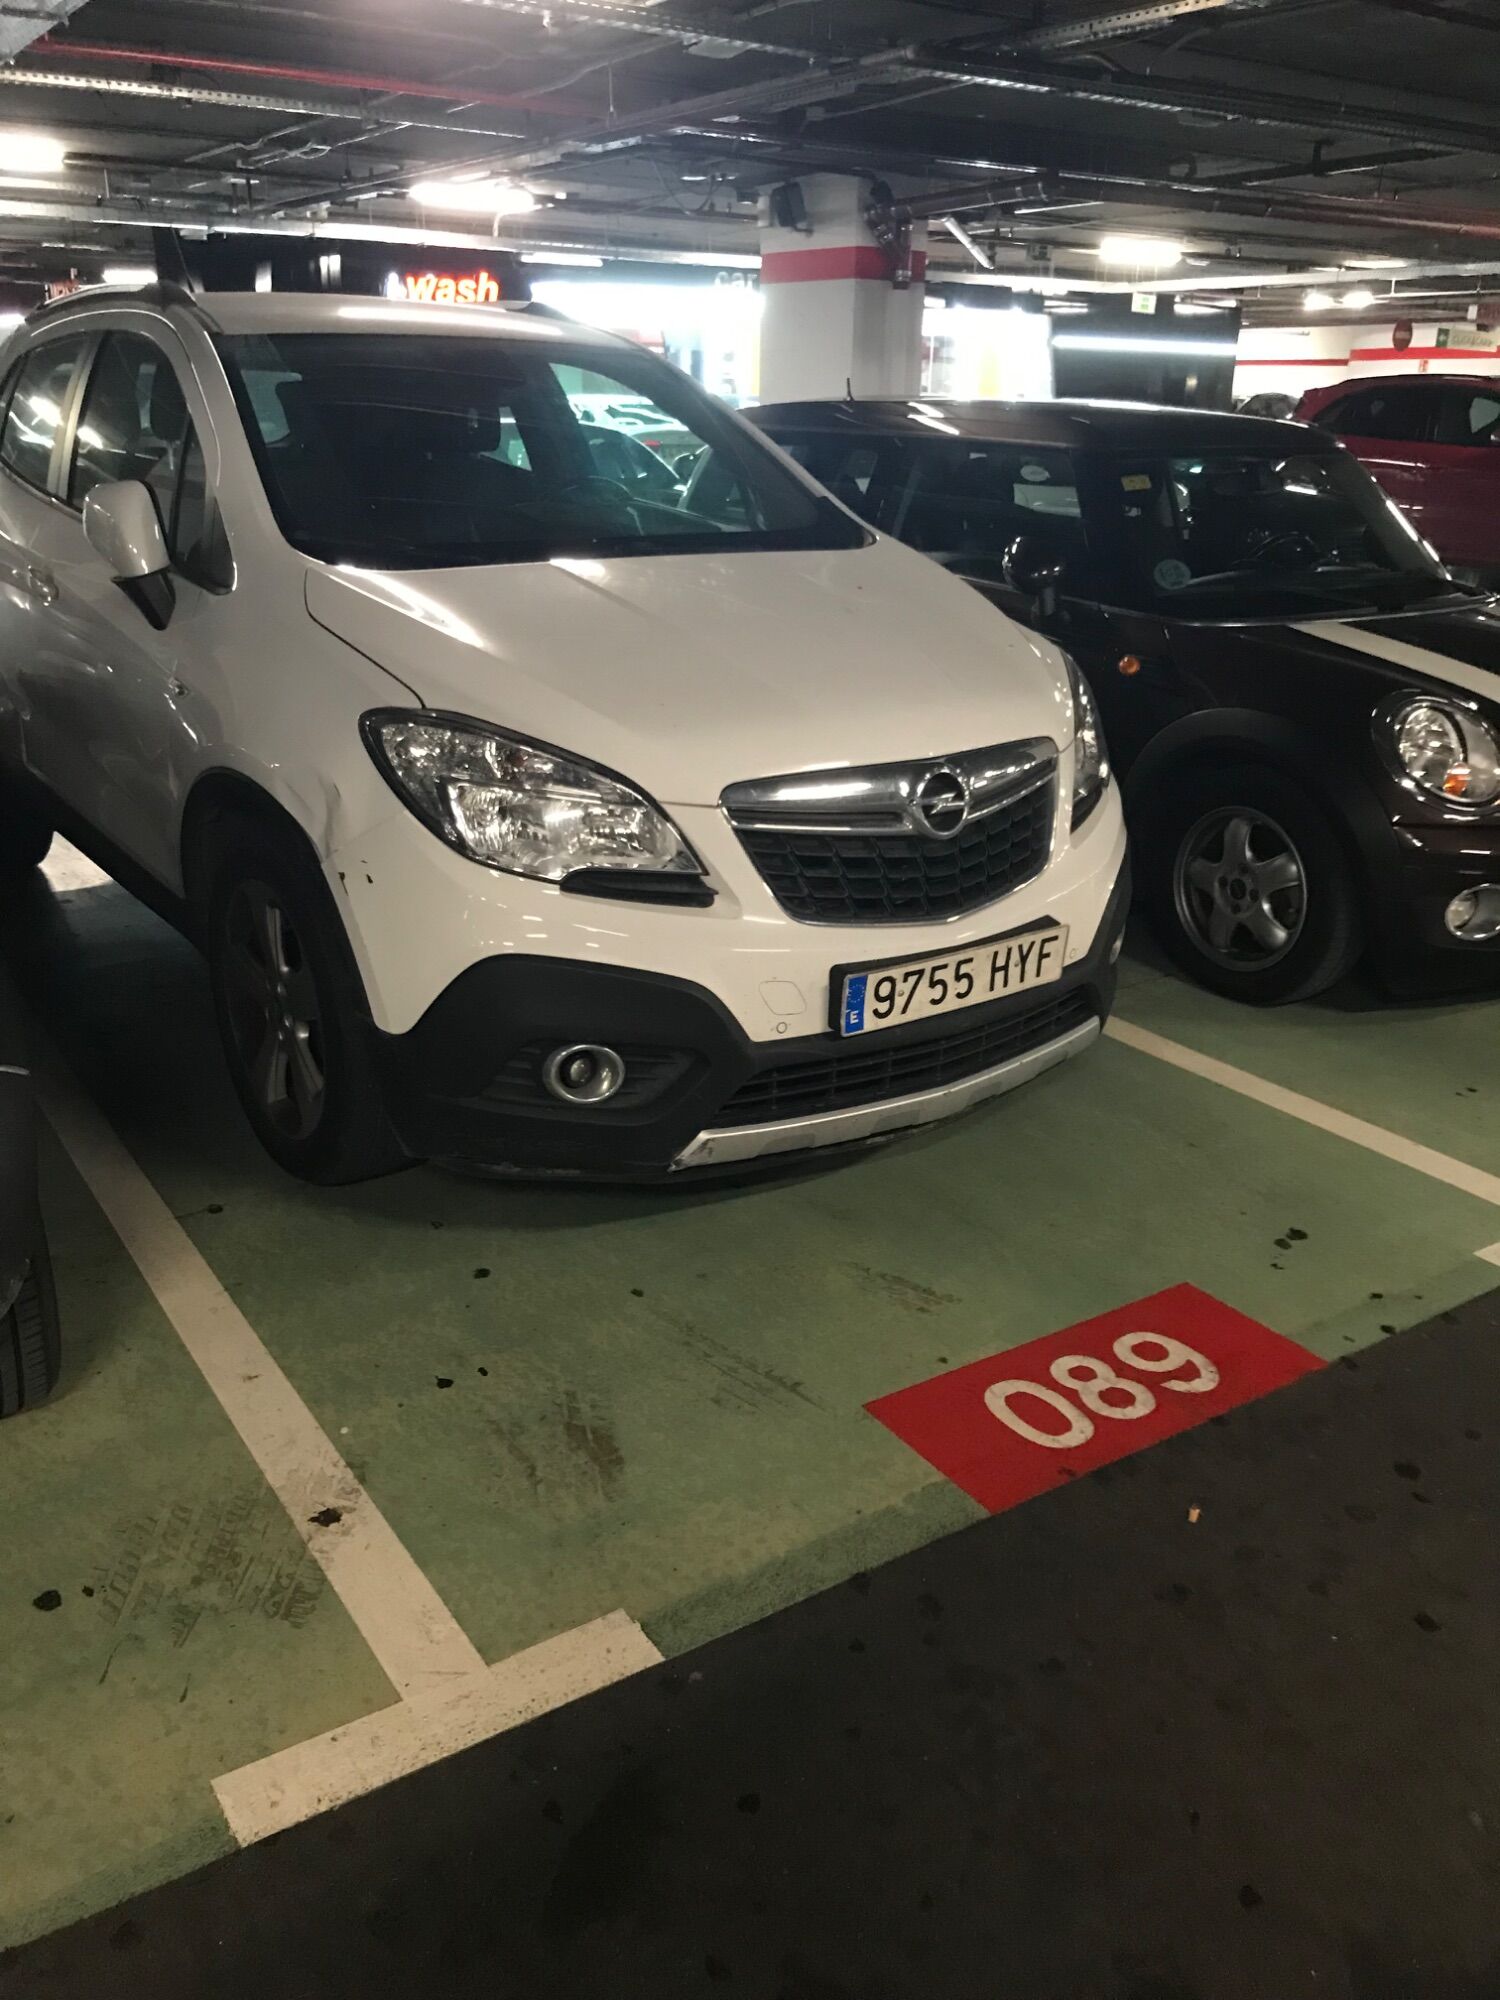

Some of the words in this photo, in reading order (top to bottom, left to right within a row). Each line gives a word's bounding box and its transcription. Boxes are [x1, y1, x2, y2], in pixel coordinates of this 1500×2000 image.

[405, 271, 499, 304] wash
[849, 1010, 859, 1025] E
[872, 957, 974, 1020] 9755
[989, 935, 1059, 992] HYF
[984, 1331, 1220, 1449] 089
